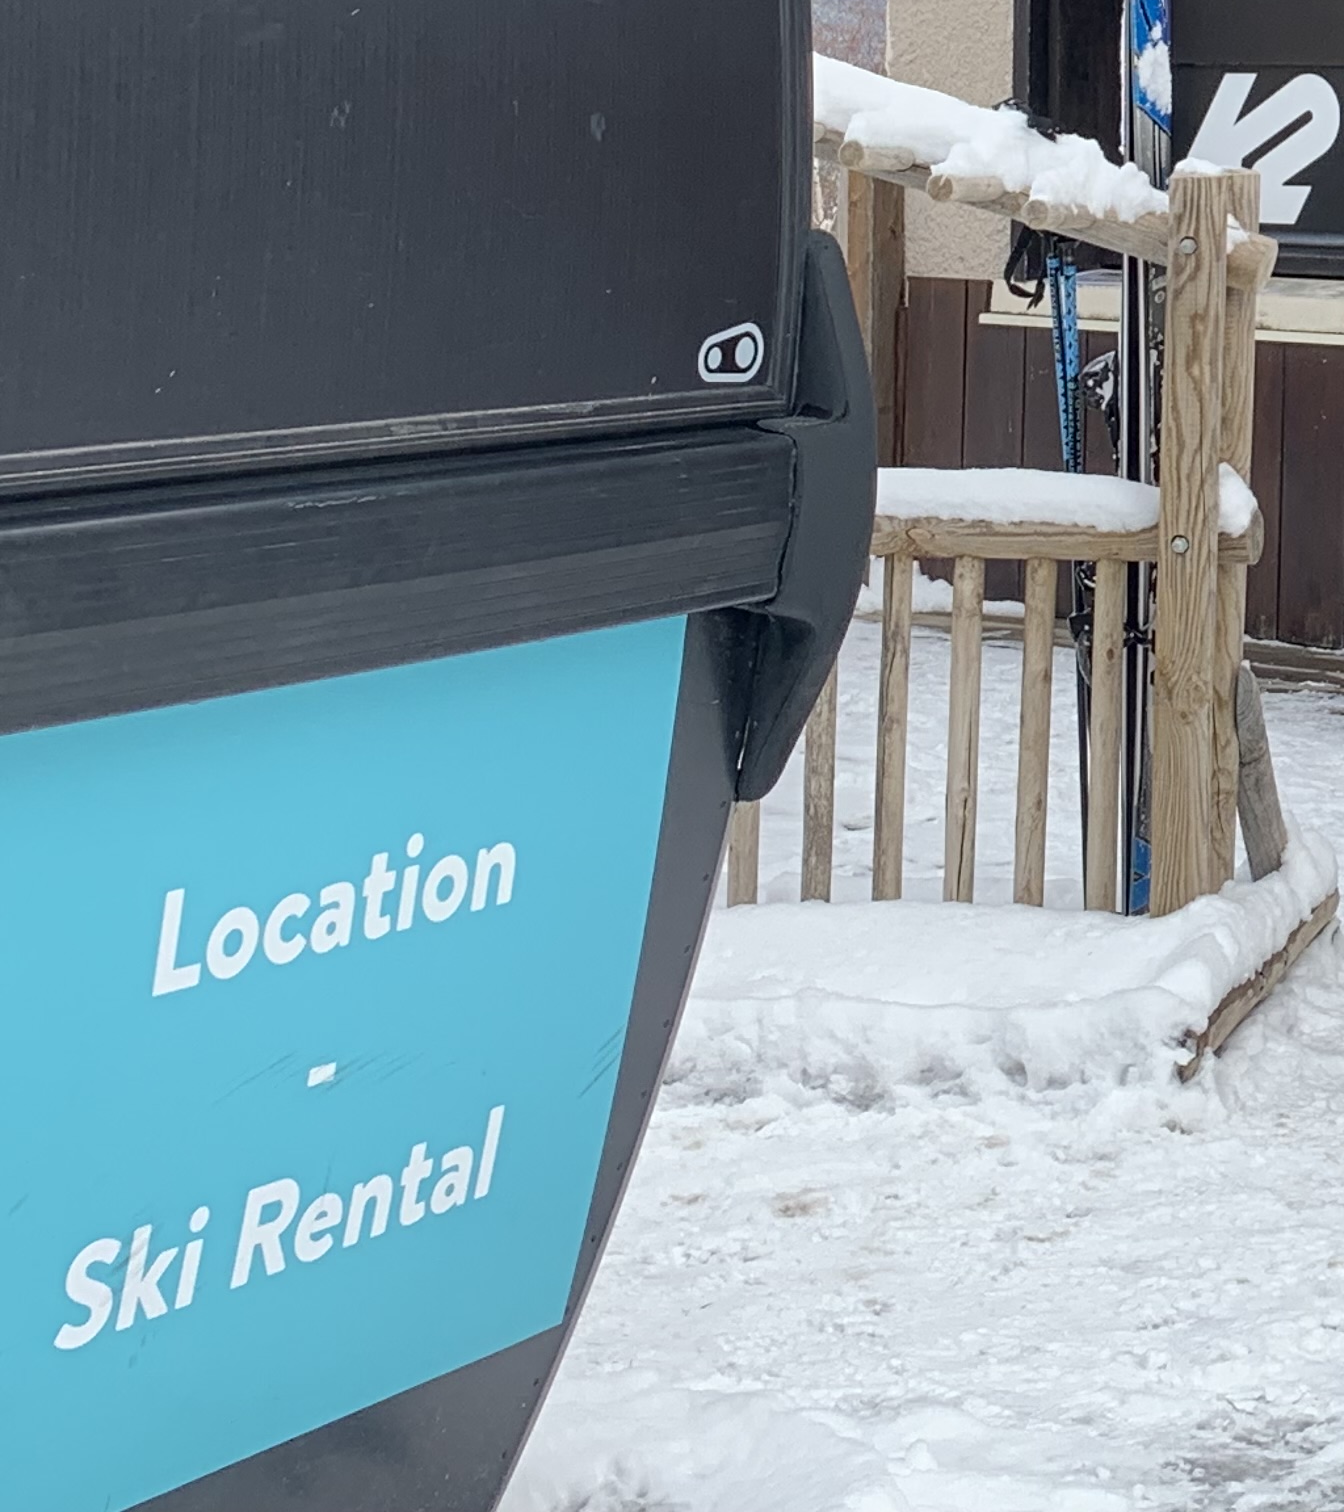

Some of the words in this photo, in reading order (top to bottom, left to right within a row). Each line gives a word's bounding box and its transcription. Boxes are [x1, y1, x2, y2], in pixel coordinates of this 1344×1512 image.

[151, 832, 516, 997] Location
[53, 1206, 210, 1350] Ski
[230, 1105, 505, 1289] Rental
